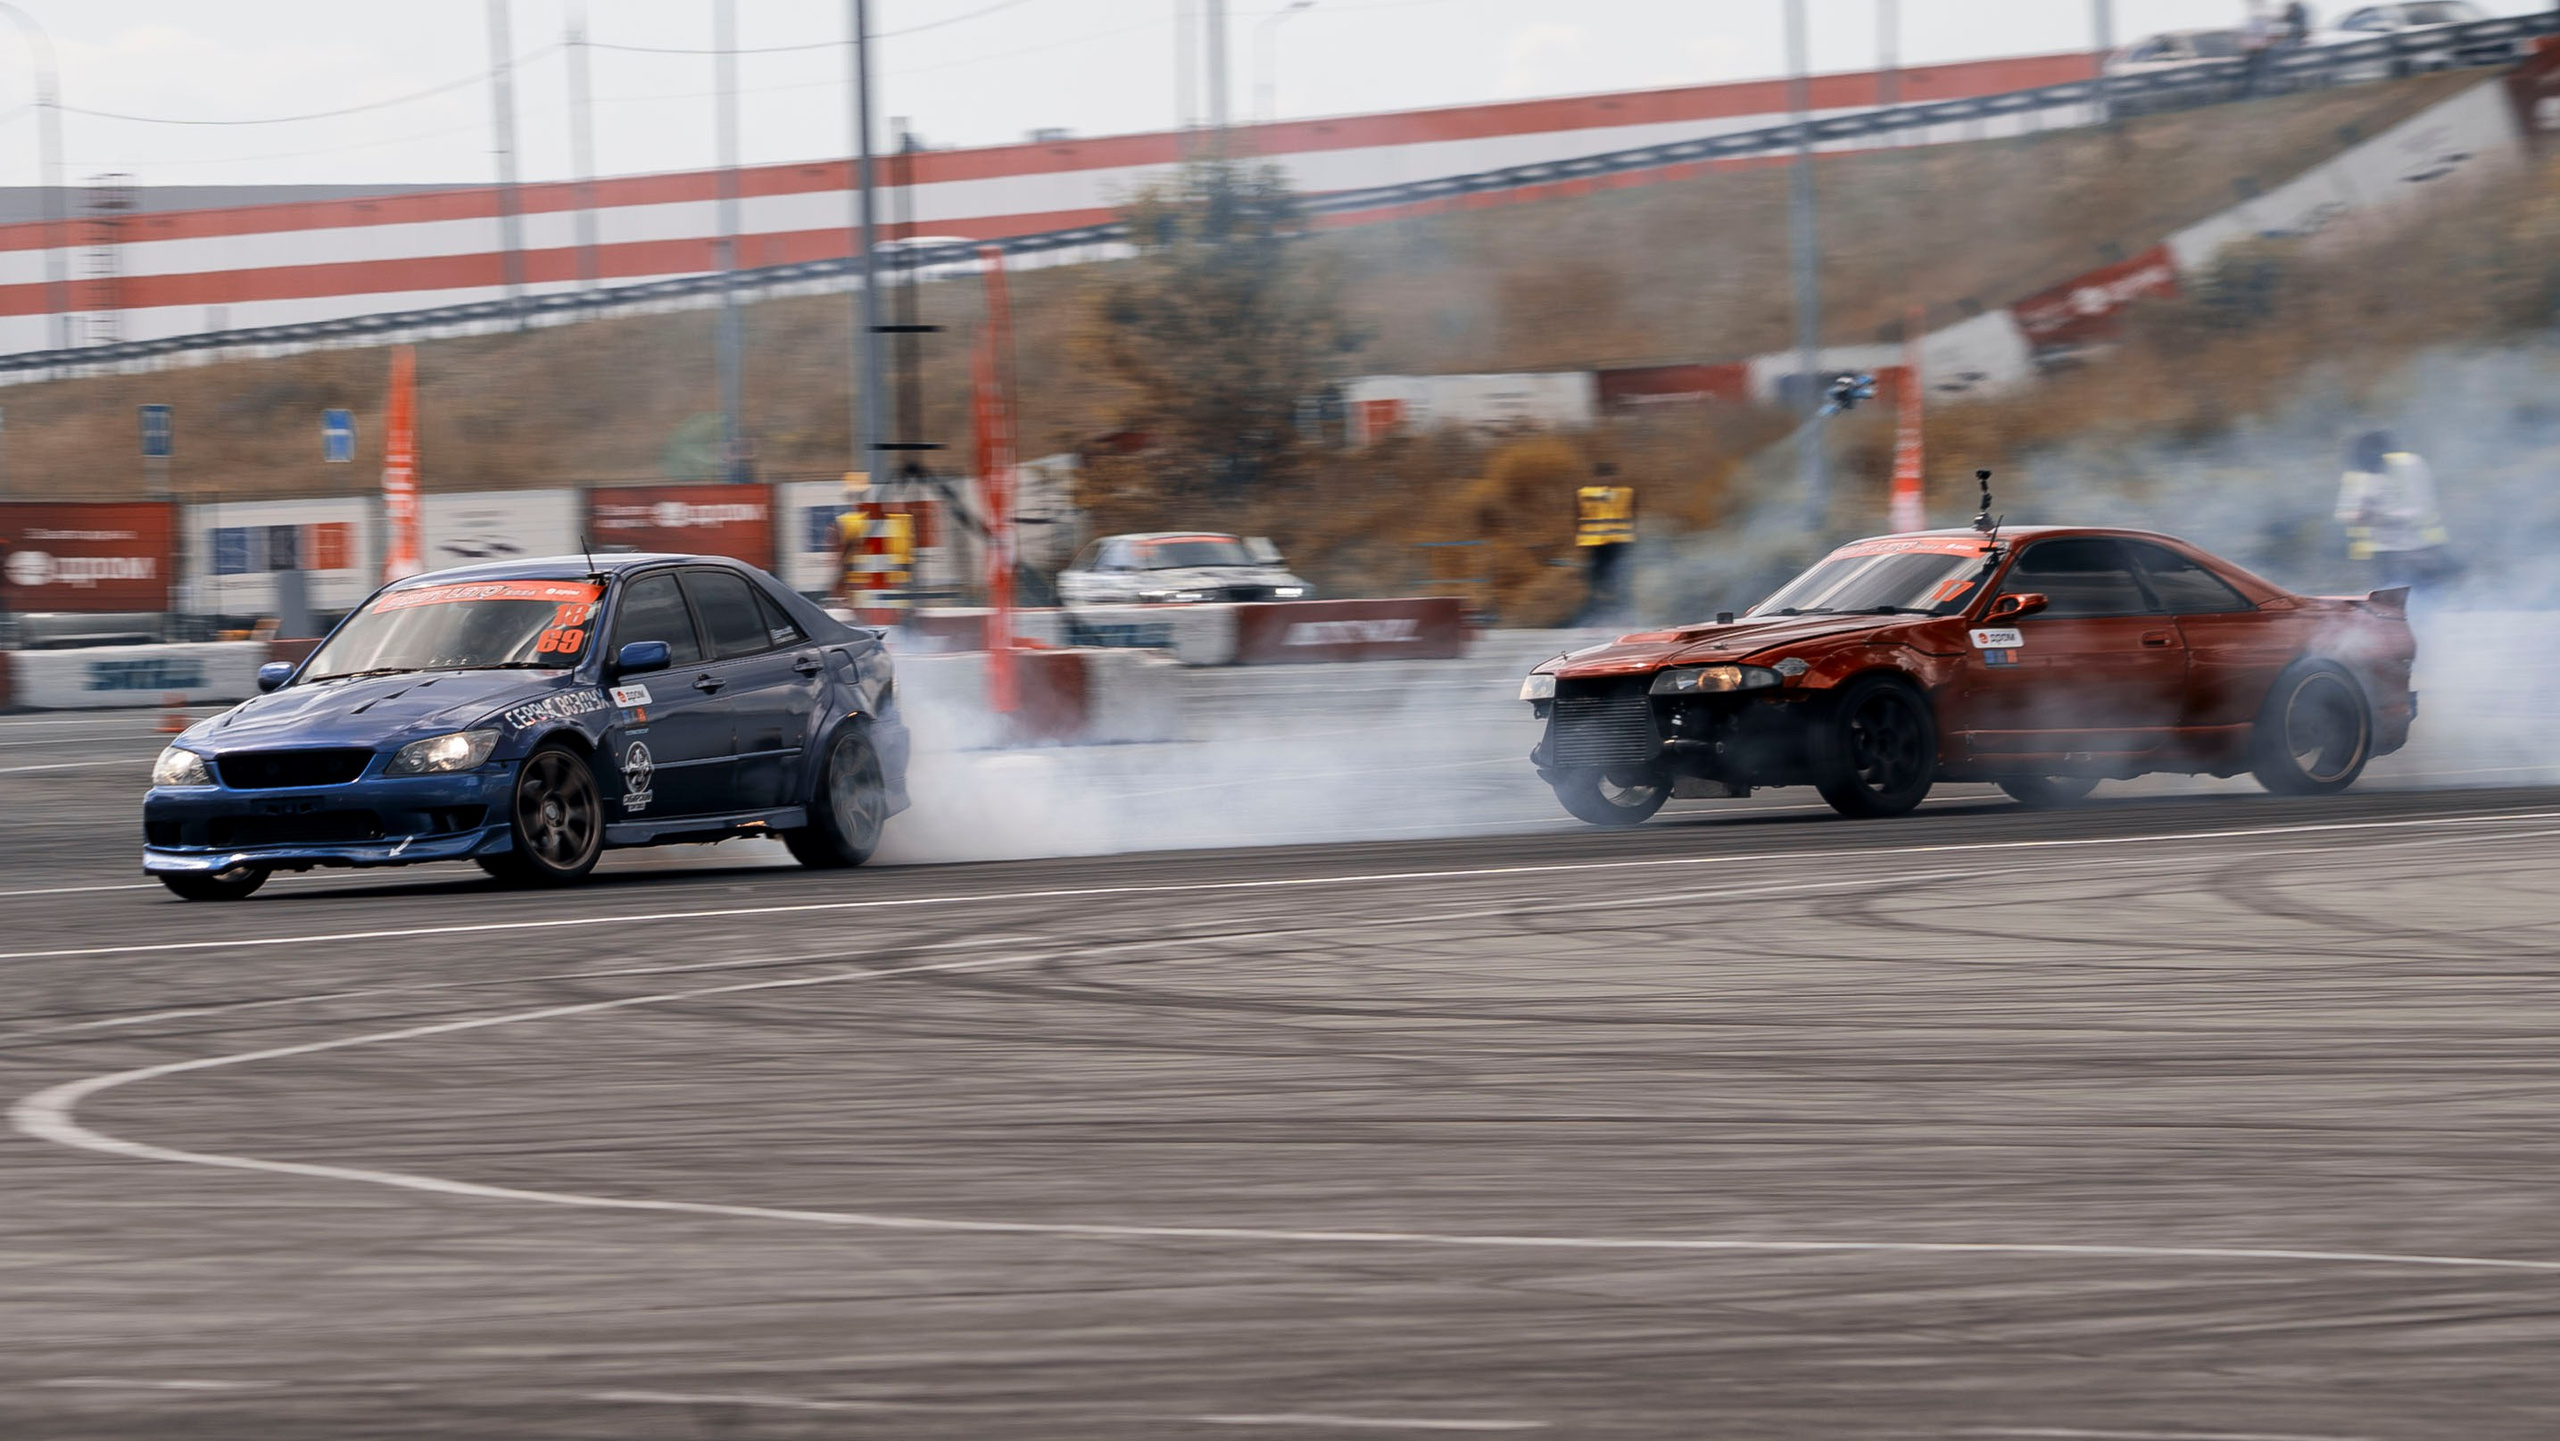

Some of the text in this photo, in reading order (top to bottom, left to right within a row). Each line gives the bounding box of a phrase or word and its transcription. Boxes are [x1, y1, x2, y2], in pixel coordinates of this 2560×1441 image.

[1931, 579, 1976, 602] 17
[553, 603, 590, 627] 18
[536, 629, 584, 654] 69
[554, 687, 611, 717] ВОЗДУХ
